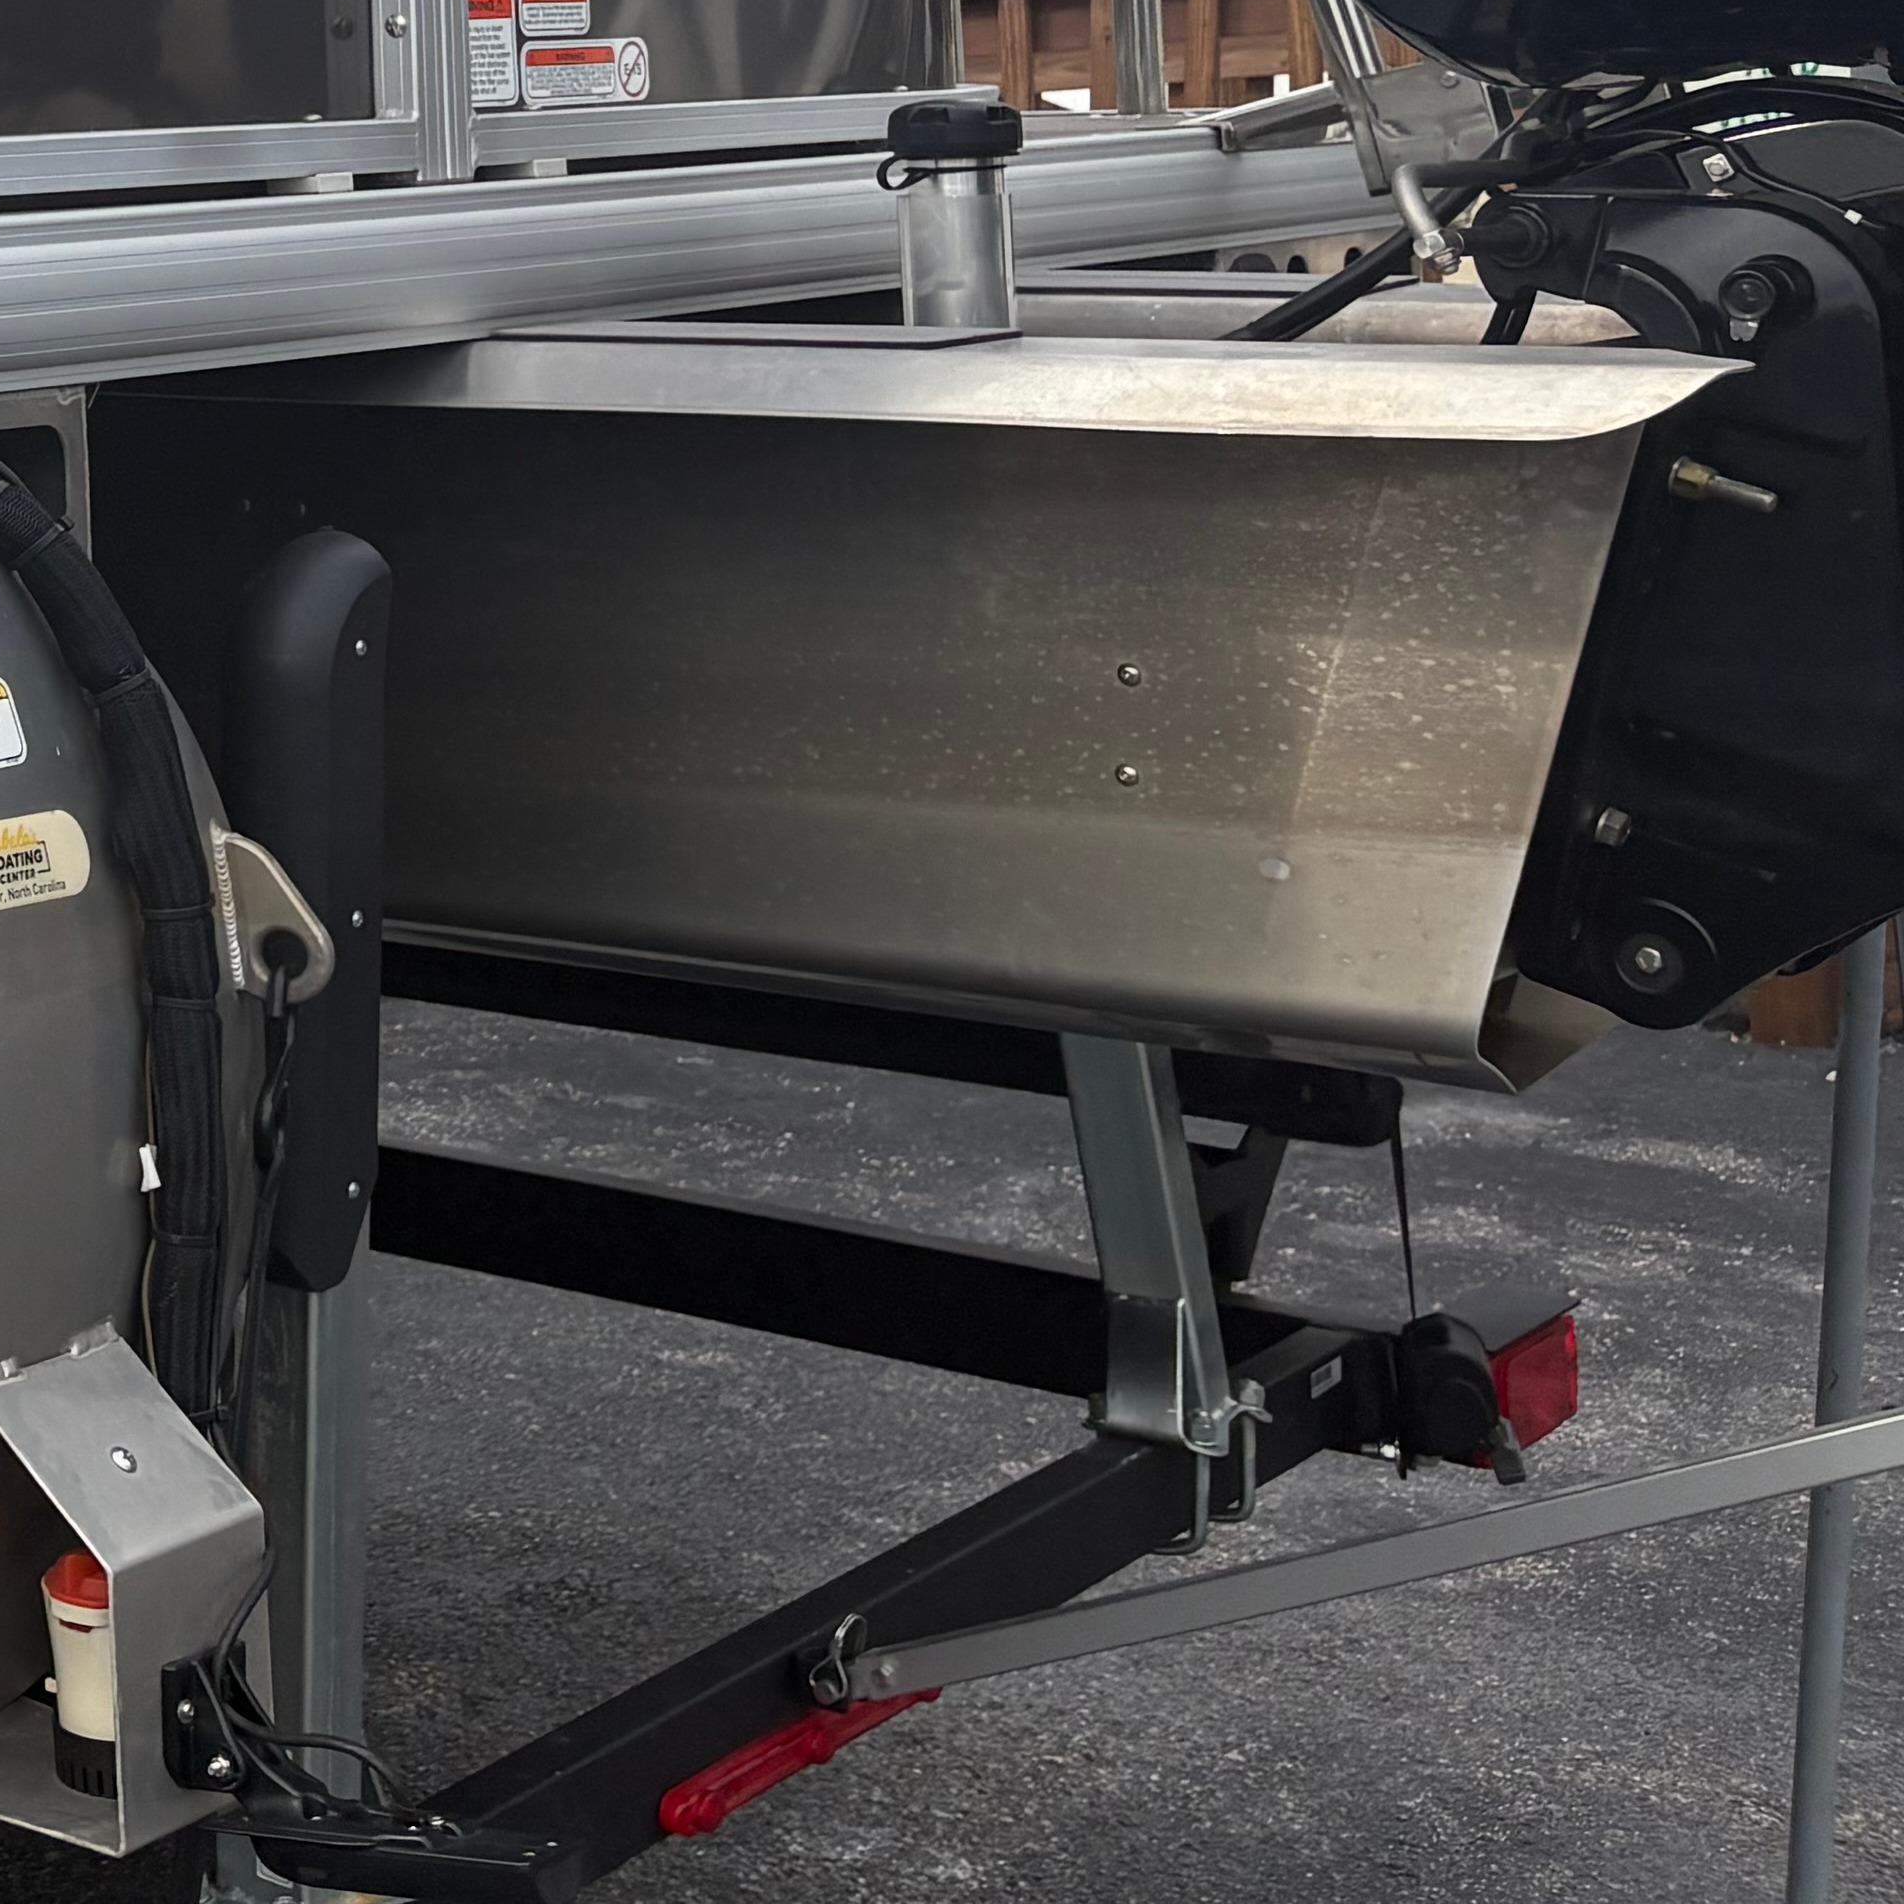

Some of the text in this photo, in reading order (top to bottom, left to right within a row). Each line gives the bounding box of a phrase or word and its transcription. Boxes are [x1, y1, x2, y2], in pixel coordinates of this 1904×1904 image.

[0, 868, 36, 884] CENTER
[7, 885, 33, 900] North
[32, 879, 67, 895] Carolina
